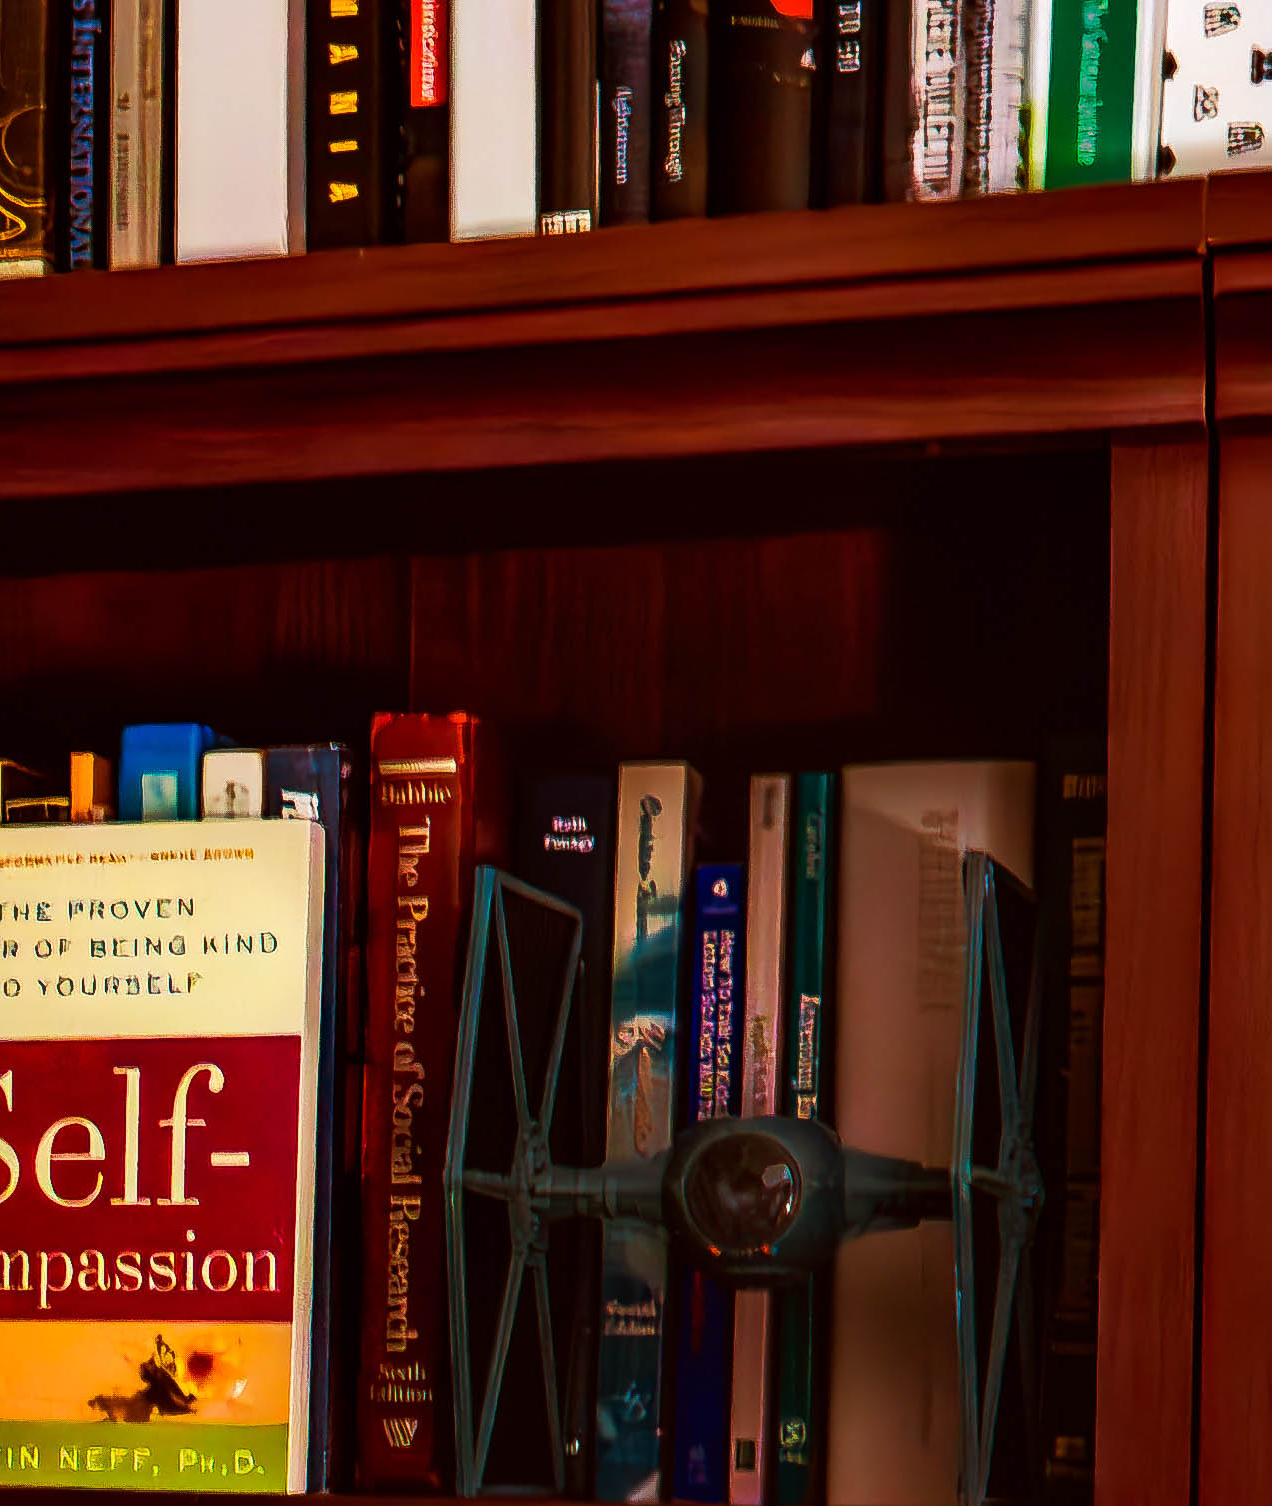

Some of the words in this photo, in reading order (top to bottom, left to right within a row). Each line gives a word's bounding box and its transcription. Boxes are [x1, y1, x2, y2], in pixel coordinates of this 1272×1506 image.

[70, 18, 103, 268] INTERNATIONAL
[397, 815, 432, 889] The
[67, 896, 196, 923] PROVEN
[33, 936, 72, 960] OF
[89, 934, 186, 959] BEING
[201, 931, 279, 956] KIND
[394, 896, 430, 1035] Practice
[37, 970, 203, 999] YOURSELF
[392, 1040, 426, 1078] of
[390, 1079, 425, 1185] Social
[385, 1195, 423, 1353] Research
[59, 1446, 160, 1478] NEFF,
